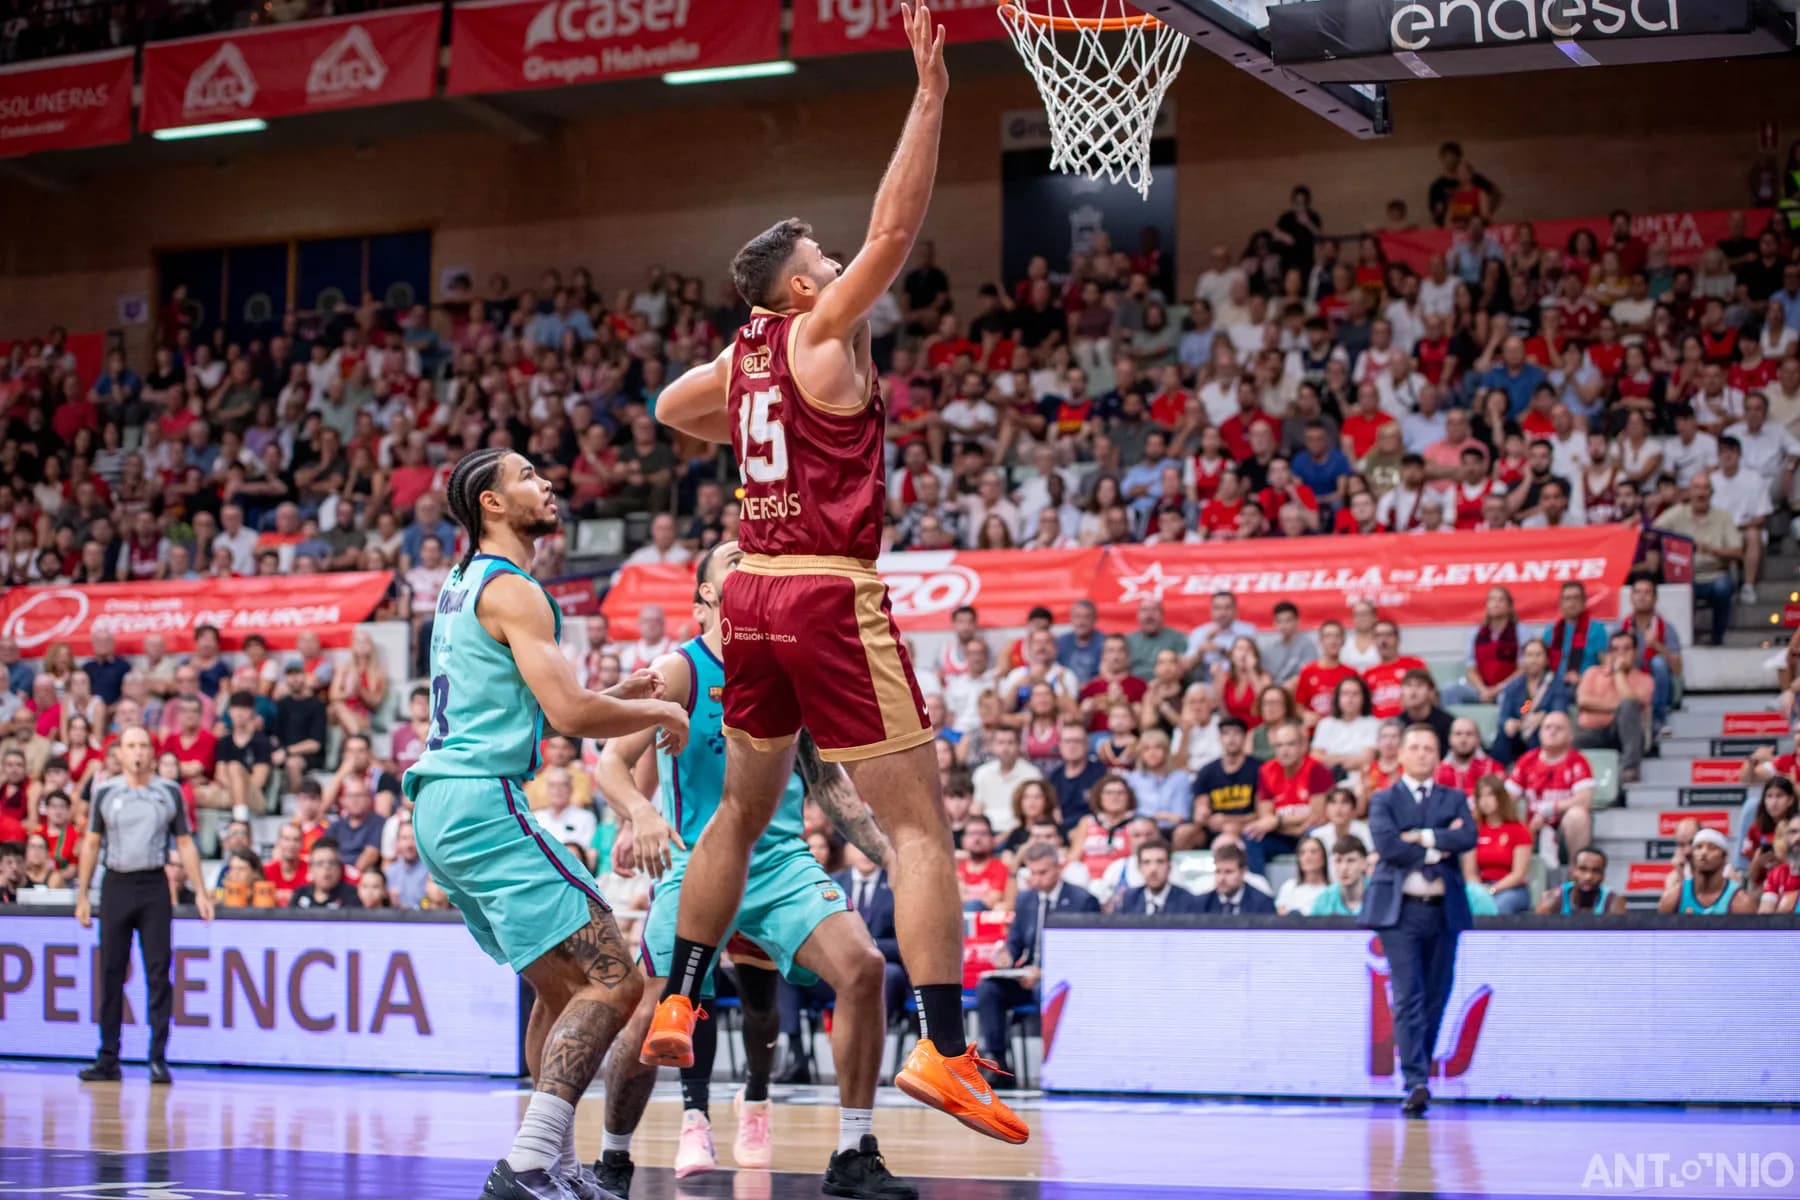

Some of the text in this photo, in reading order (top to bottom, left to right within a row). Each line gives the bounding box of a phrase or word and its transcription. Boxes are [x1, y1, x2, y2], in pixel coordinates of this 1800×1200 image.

[1390, 0, 1679, 50] endesa
[523, 55, 599, 82] Grupo
[739, 385, 788, 485] 15
[1181, 565, 1385, 596] ESTRELLA
[1417, 557, 1608, 587] LEVANTE
[0, 943, 432, 1036] PEENCIA
